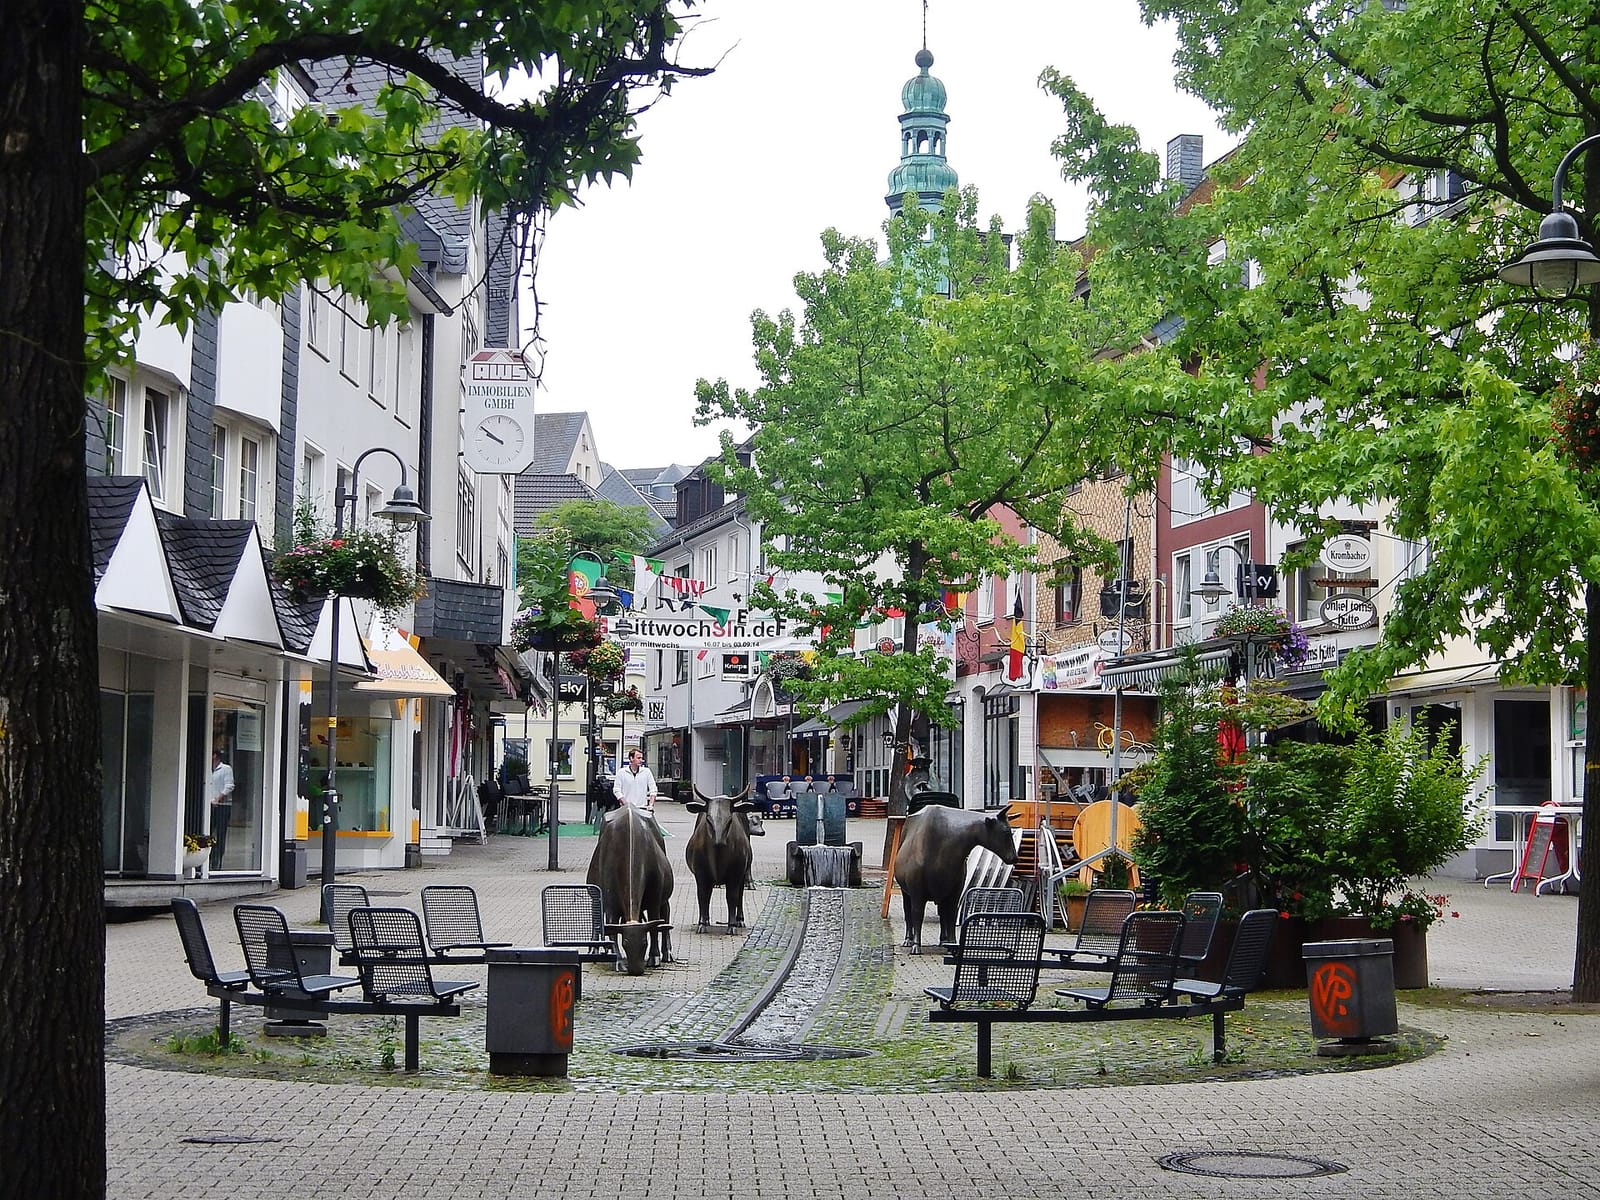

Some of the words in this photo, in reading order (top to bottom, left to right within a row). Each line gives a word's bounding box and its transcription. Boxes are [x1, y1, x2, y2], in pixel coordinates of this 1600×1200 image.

[468, 386, 531, 397] IMMOBILIEN
[484, 399, 515, 409] GMBH
[1330, 550, 1366, 560] Krombacher
[1326, 600, 1348, 612] onkel
[617, 619, 774, 638] ittwochSIn.de
[640, 641, 680, 649] mittwochs
[560, 681, 584, 695] sky
